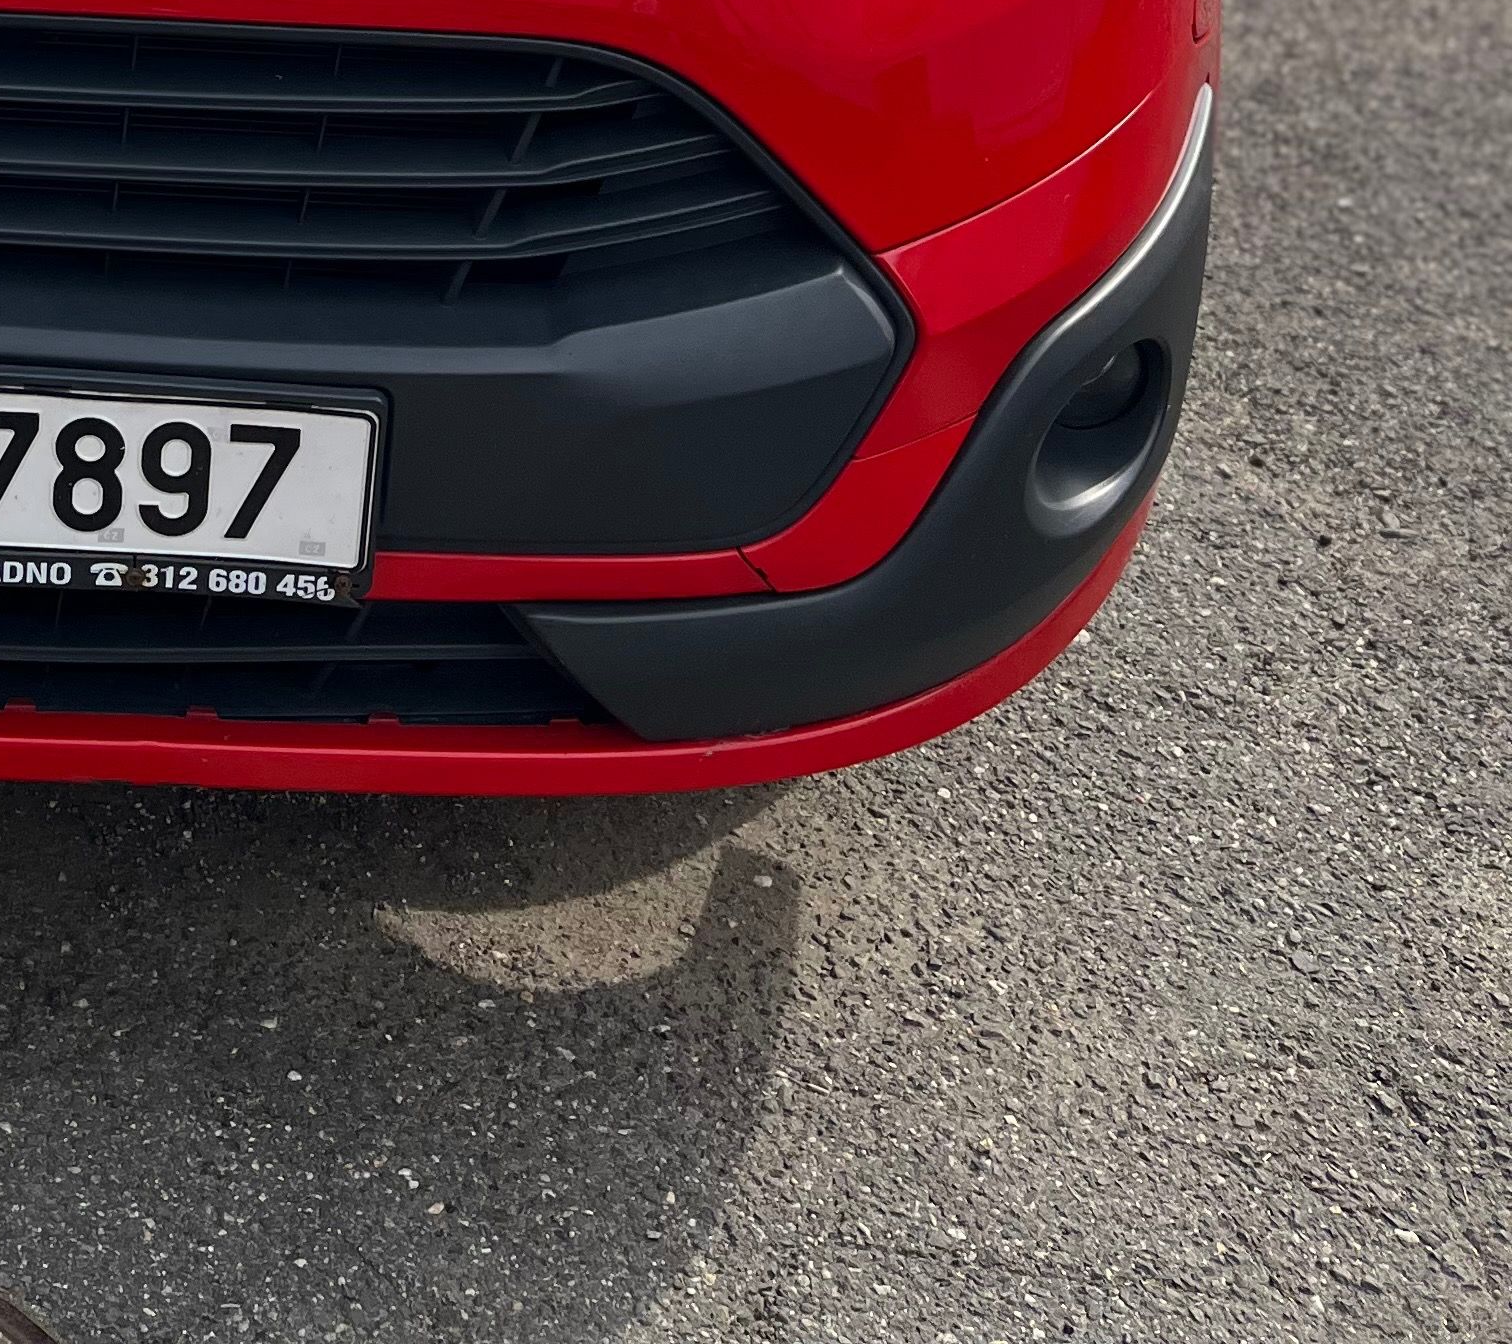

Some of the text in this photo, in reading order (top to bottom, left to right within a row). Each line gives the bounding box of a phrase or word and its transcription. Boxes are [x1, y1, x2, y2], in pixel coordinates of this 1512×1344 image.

[141, 563, 198, 591] 312
[208, 568, 267, 596] 680
[275, 574, 336, 602] 456
